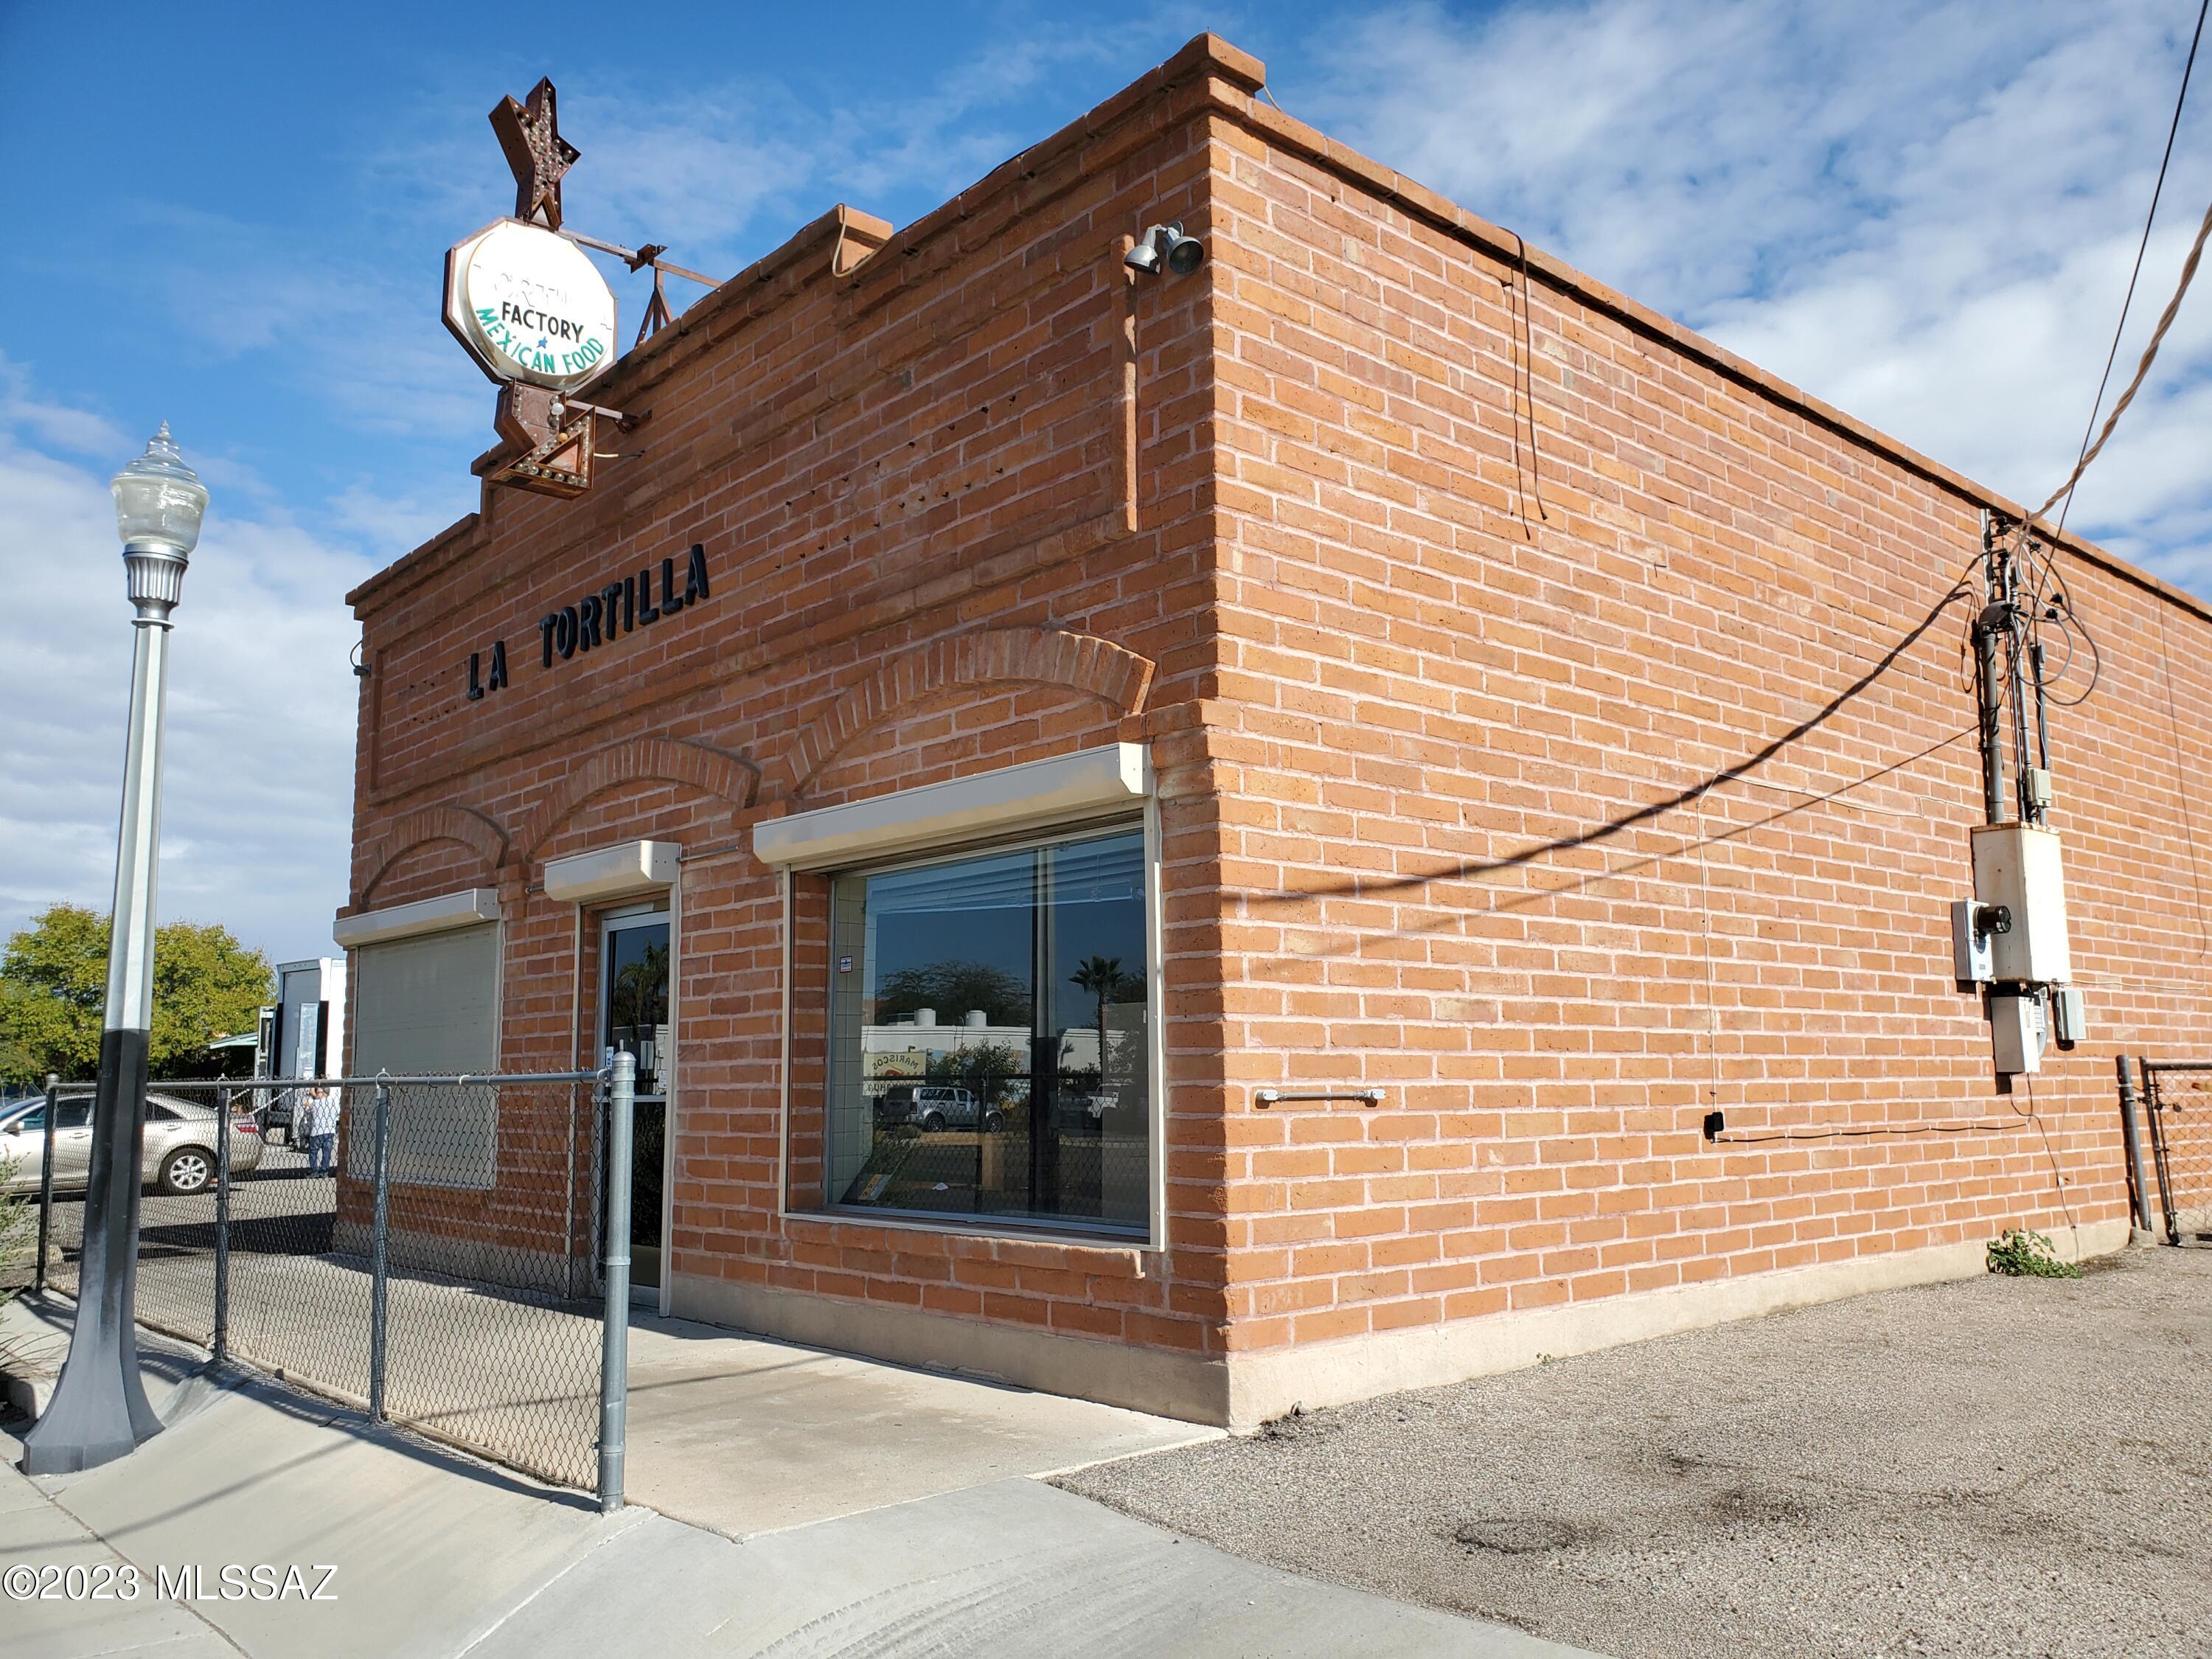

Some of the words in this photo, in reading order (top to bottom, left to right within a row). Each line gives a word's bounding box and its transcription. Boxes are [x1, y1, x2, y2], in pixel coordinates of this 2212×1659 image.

[476, 308, 556, 374] MEXICAN
[562, 338, 605, 374] FOOD
[502, 301, 584, 344] FACTORY
[466, 641, 508, 701] LA
[538, 543, 710, 668] TORTILLA
